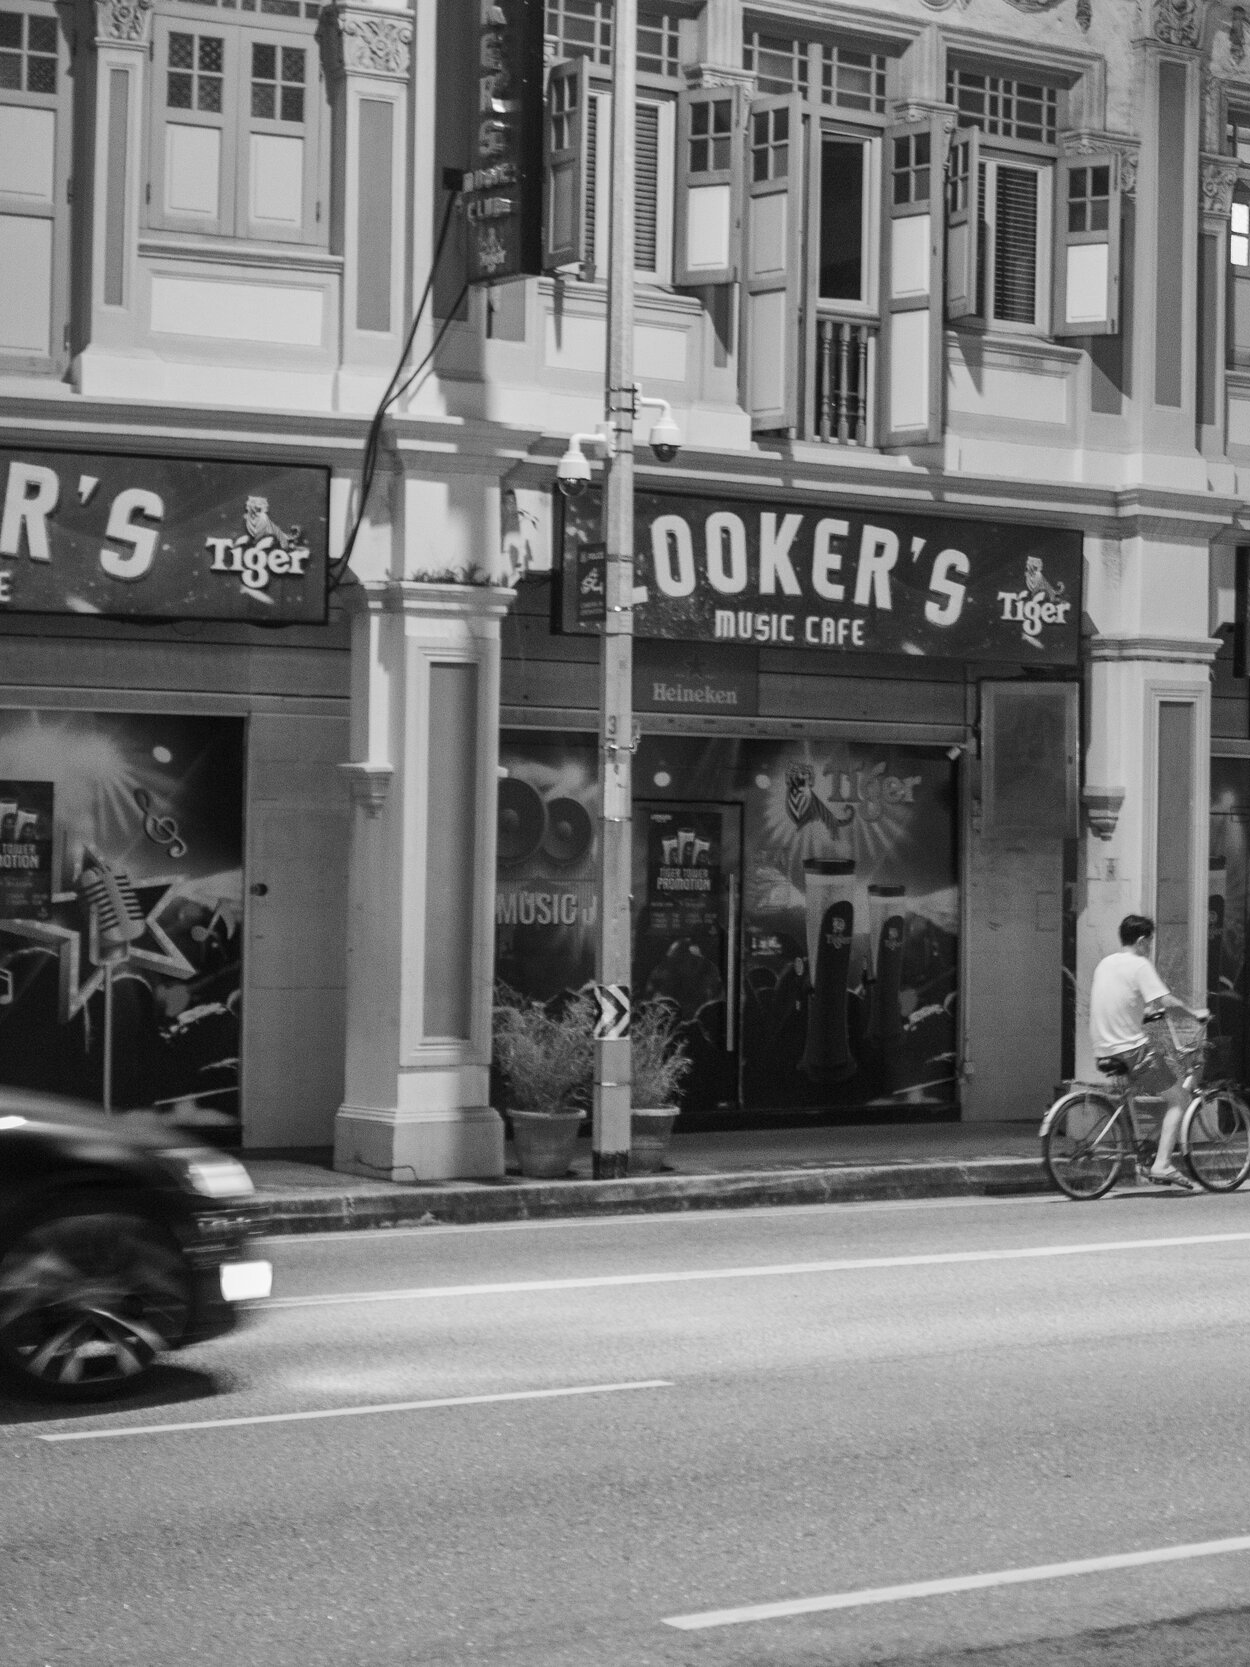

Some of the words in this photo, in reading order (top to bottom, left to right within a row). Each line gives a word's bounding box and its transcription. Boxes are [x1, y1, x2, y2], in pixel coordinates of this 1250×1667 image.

[205, 535, 310, 588] Tiger
[632, 511, 971, 627] OOKER'S
[715, 609, 795, 641] MUSIC
[805, 616, 865, 646] CAFE
[997, 590, 1072, 636] Tiger
[652, 682, 738, 704] Heineken
[823, 759, 922, 822] Tiger
[0, 855, 39, 869] OTION
[657, 877, 711, 891] PROMOTION
[496, 892, 577, 925] MUSIC
